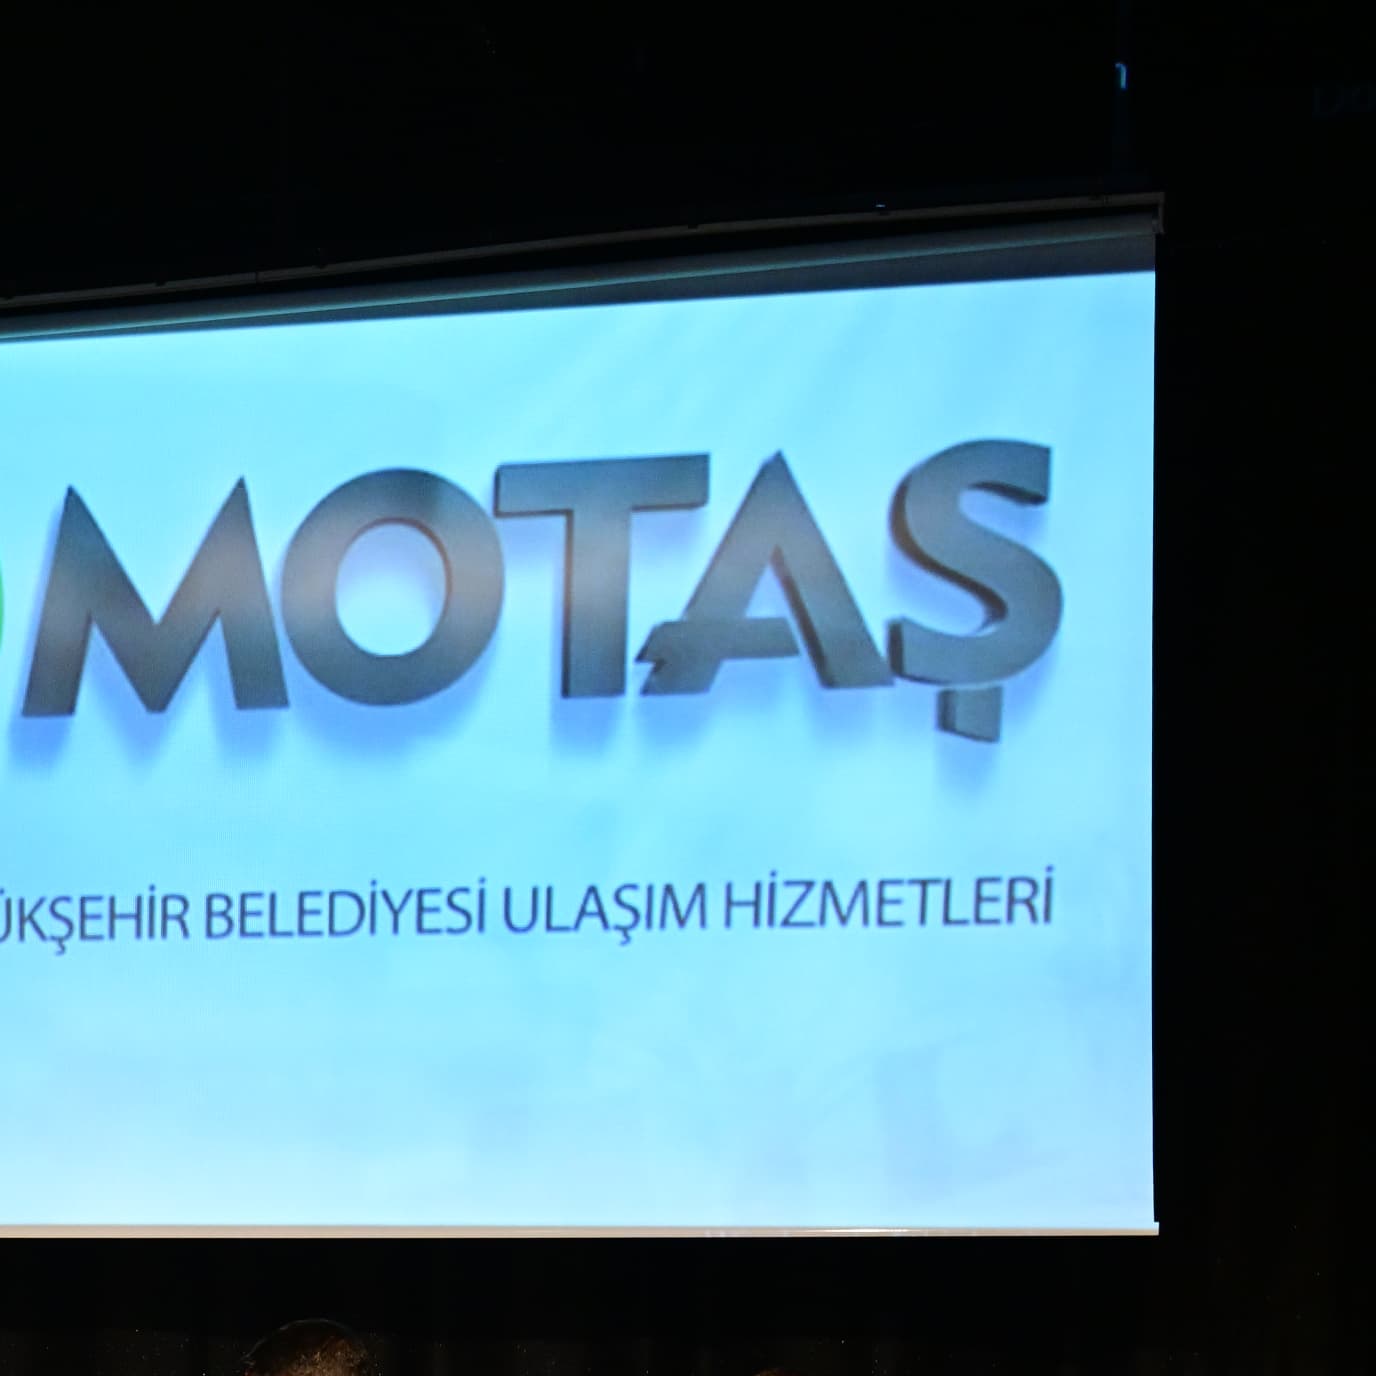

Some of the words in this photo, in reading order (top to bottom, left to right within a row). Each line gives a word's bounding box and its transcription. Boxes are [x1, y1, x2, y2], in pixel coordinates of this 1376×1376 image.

[22, 438, 1064, 743] MOTAŞ
[204, 876, 487, 942] BELEDİYESİ
[502, 881, 708, 947] ULAŞIM
[723, 866, 1055, 930] HİZMETLERİ
